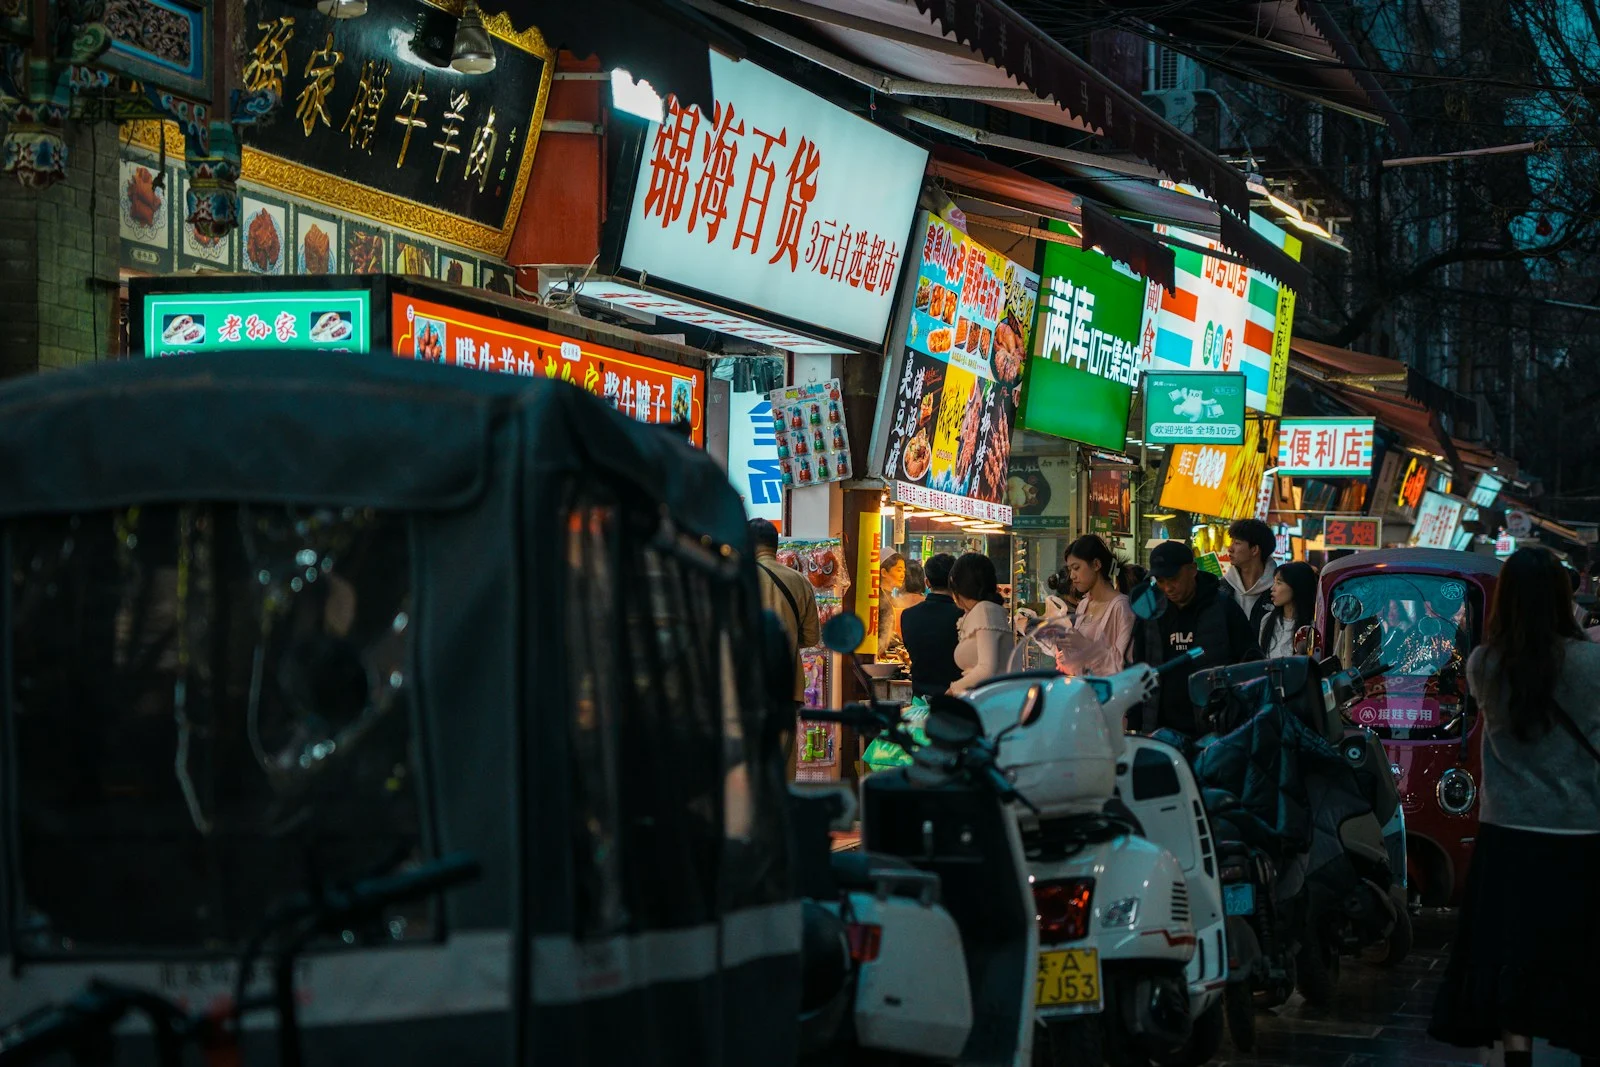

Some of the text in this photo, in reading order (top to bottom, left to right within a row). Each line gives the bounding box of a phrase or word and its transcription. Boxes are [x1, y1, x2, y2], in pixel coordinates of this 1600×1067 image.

[643, 93, 821, 273] 锦海百货
[805, 219, 899, 296] 3元自选超市
[219, 312, 298, 342] 老孙家
[1042, 275, 1141, 388] 满库 10元集合店
[1154, 425, 1237, 436] 欢迎光临 全场10元
[1289, 428, 1363, 468] 便利店
[1326, 520, 1376, 545] 名烟
[1170, 631, 1193, 645] FILA
